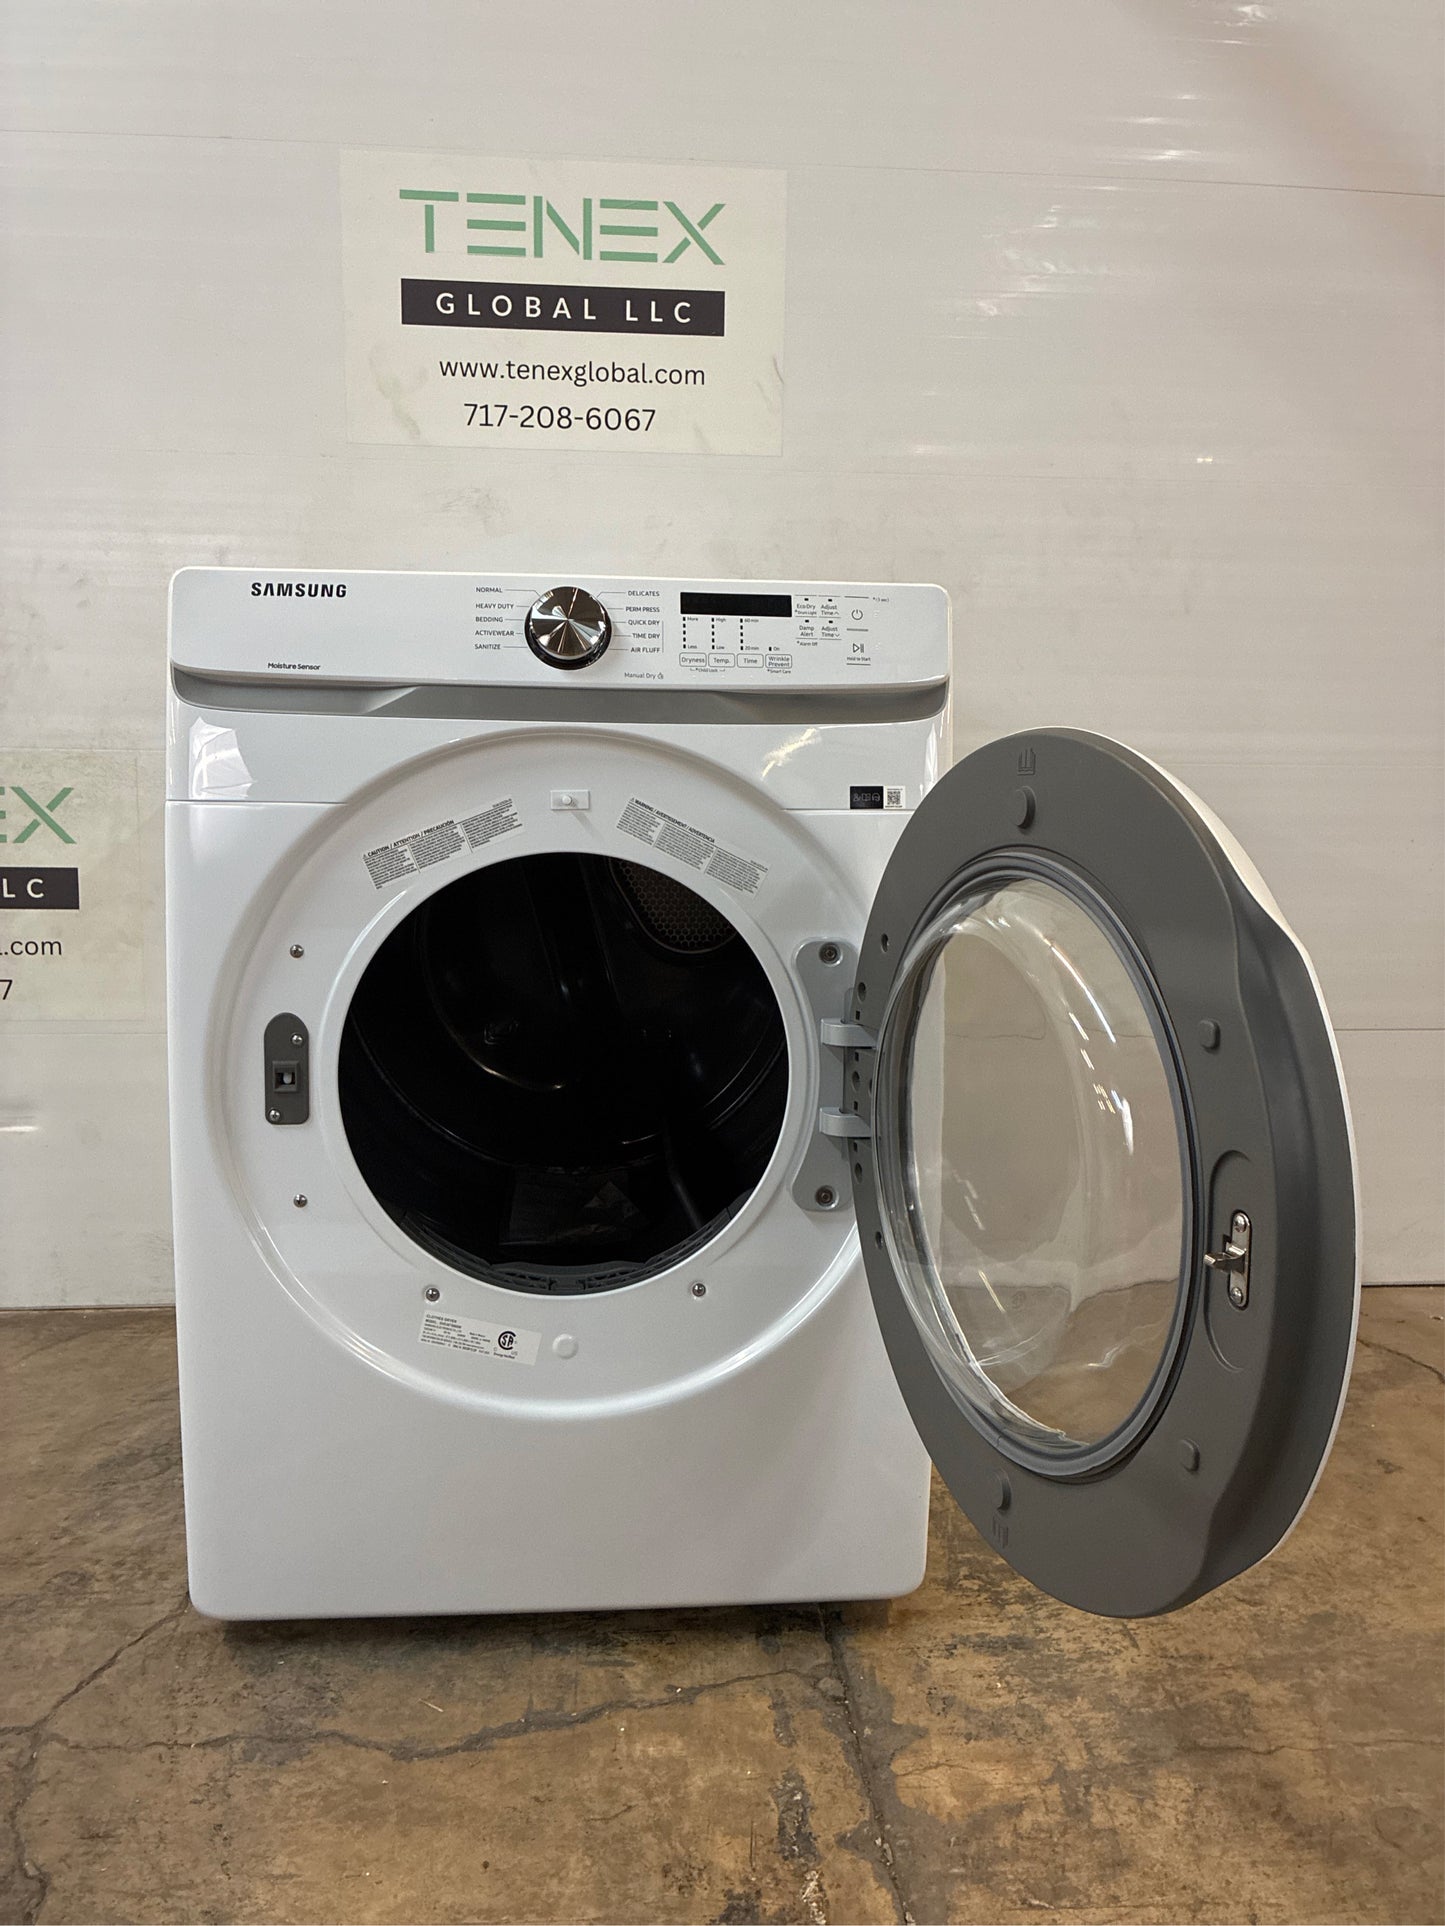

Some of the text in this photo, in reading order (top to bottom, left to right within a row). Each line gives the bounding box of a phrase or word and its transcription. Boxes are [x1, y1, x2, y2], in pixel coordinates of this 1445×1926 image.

[399, 188, 726, 265] TENEX
[435, 291, 693, 324] GLOBAL LLC
[439, 357, 706, 387] www.tenexglobal.com
[463, 402, 657, 432] 717-208-6067
[250, 581, 348, 599] SAMSUNG
[267, 662, 321, 671] Moisture Sensor
[681, 656, 706, 664] Dryness
[646, 672, 657, 680] Dry
[634, 799, 654, 813] WARNING
[367, 845, 390, 857] CAUTION
[393, 833, 420, 848] ATTENTION
[423, 819, 454, 835] PRECAUCIÓN
